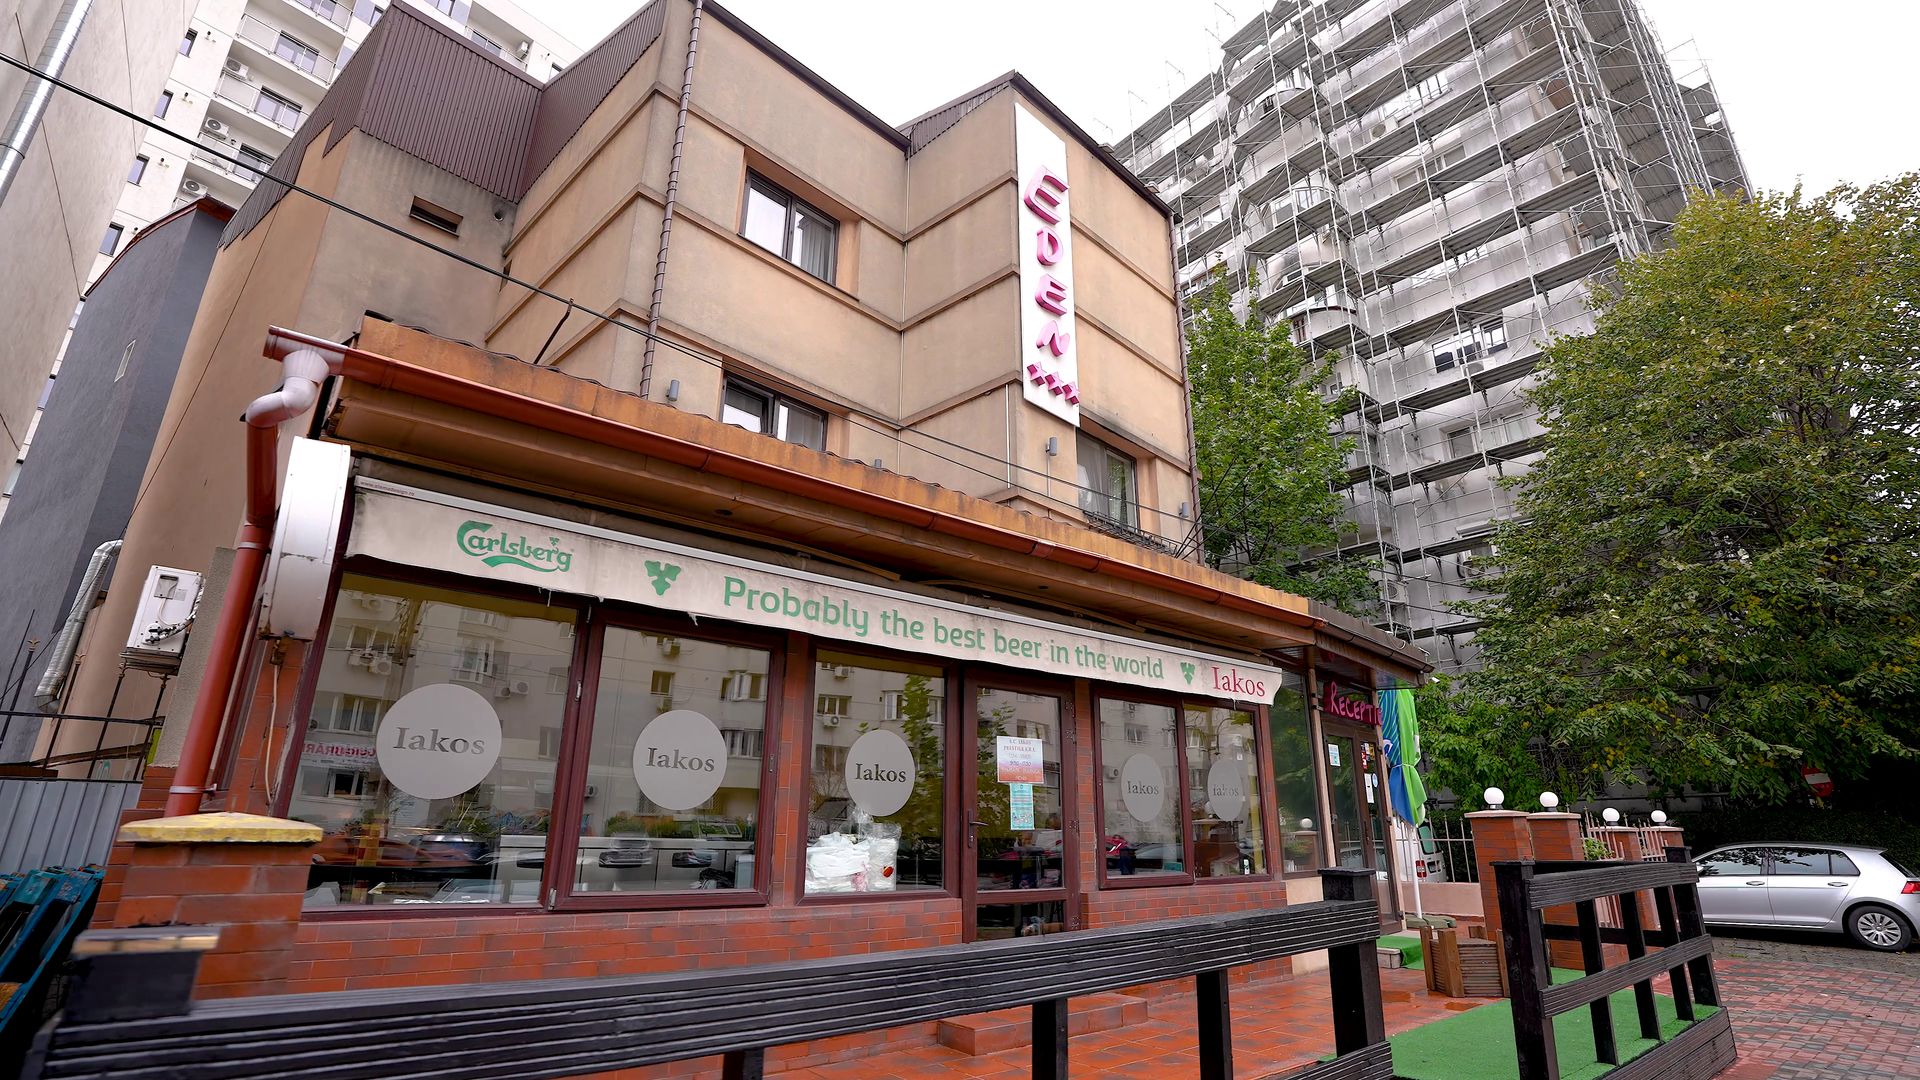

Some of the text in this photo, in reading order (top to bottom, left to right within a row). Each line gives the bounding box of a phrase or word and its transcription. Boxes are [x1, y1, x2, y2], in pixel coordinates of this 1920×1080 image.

[1023, 164, 1070, 357] EDEN
[457, 520, 573, 573] Carlsberg
[724, 576, 1165, 679] Probably the best beer in the world
[1211, 666, 1266, 697] Iakos
[393, 726, 486, 755] Iakos
[646, 747, 715, 773] Iakos
[855, 763, 907, 783] Iakos
[1127, 780, 1160, 796] Iakos
